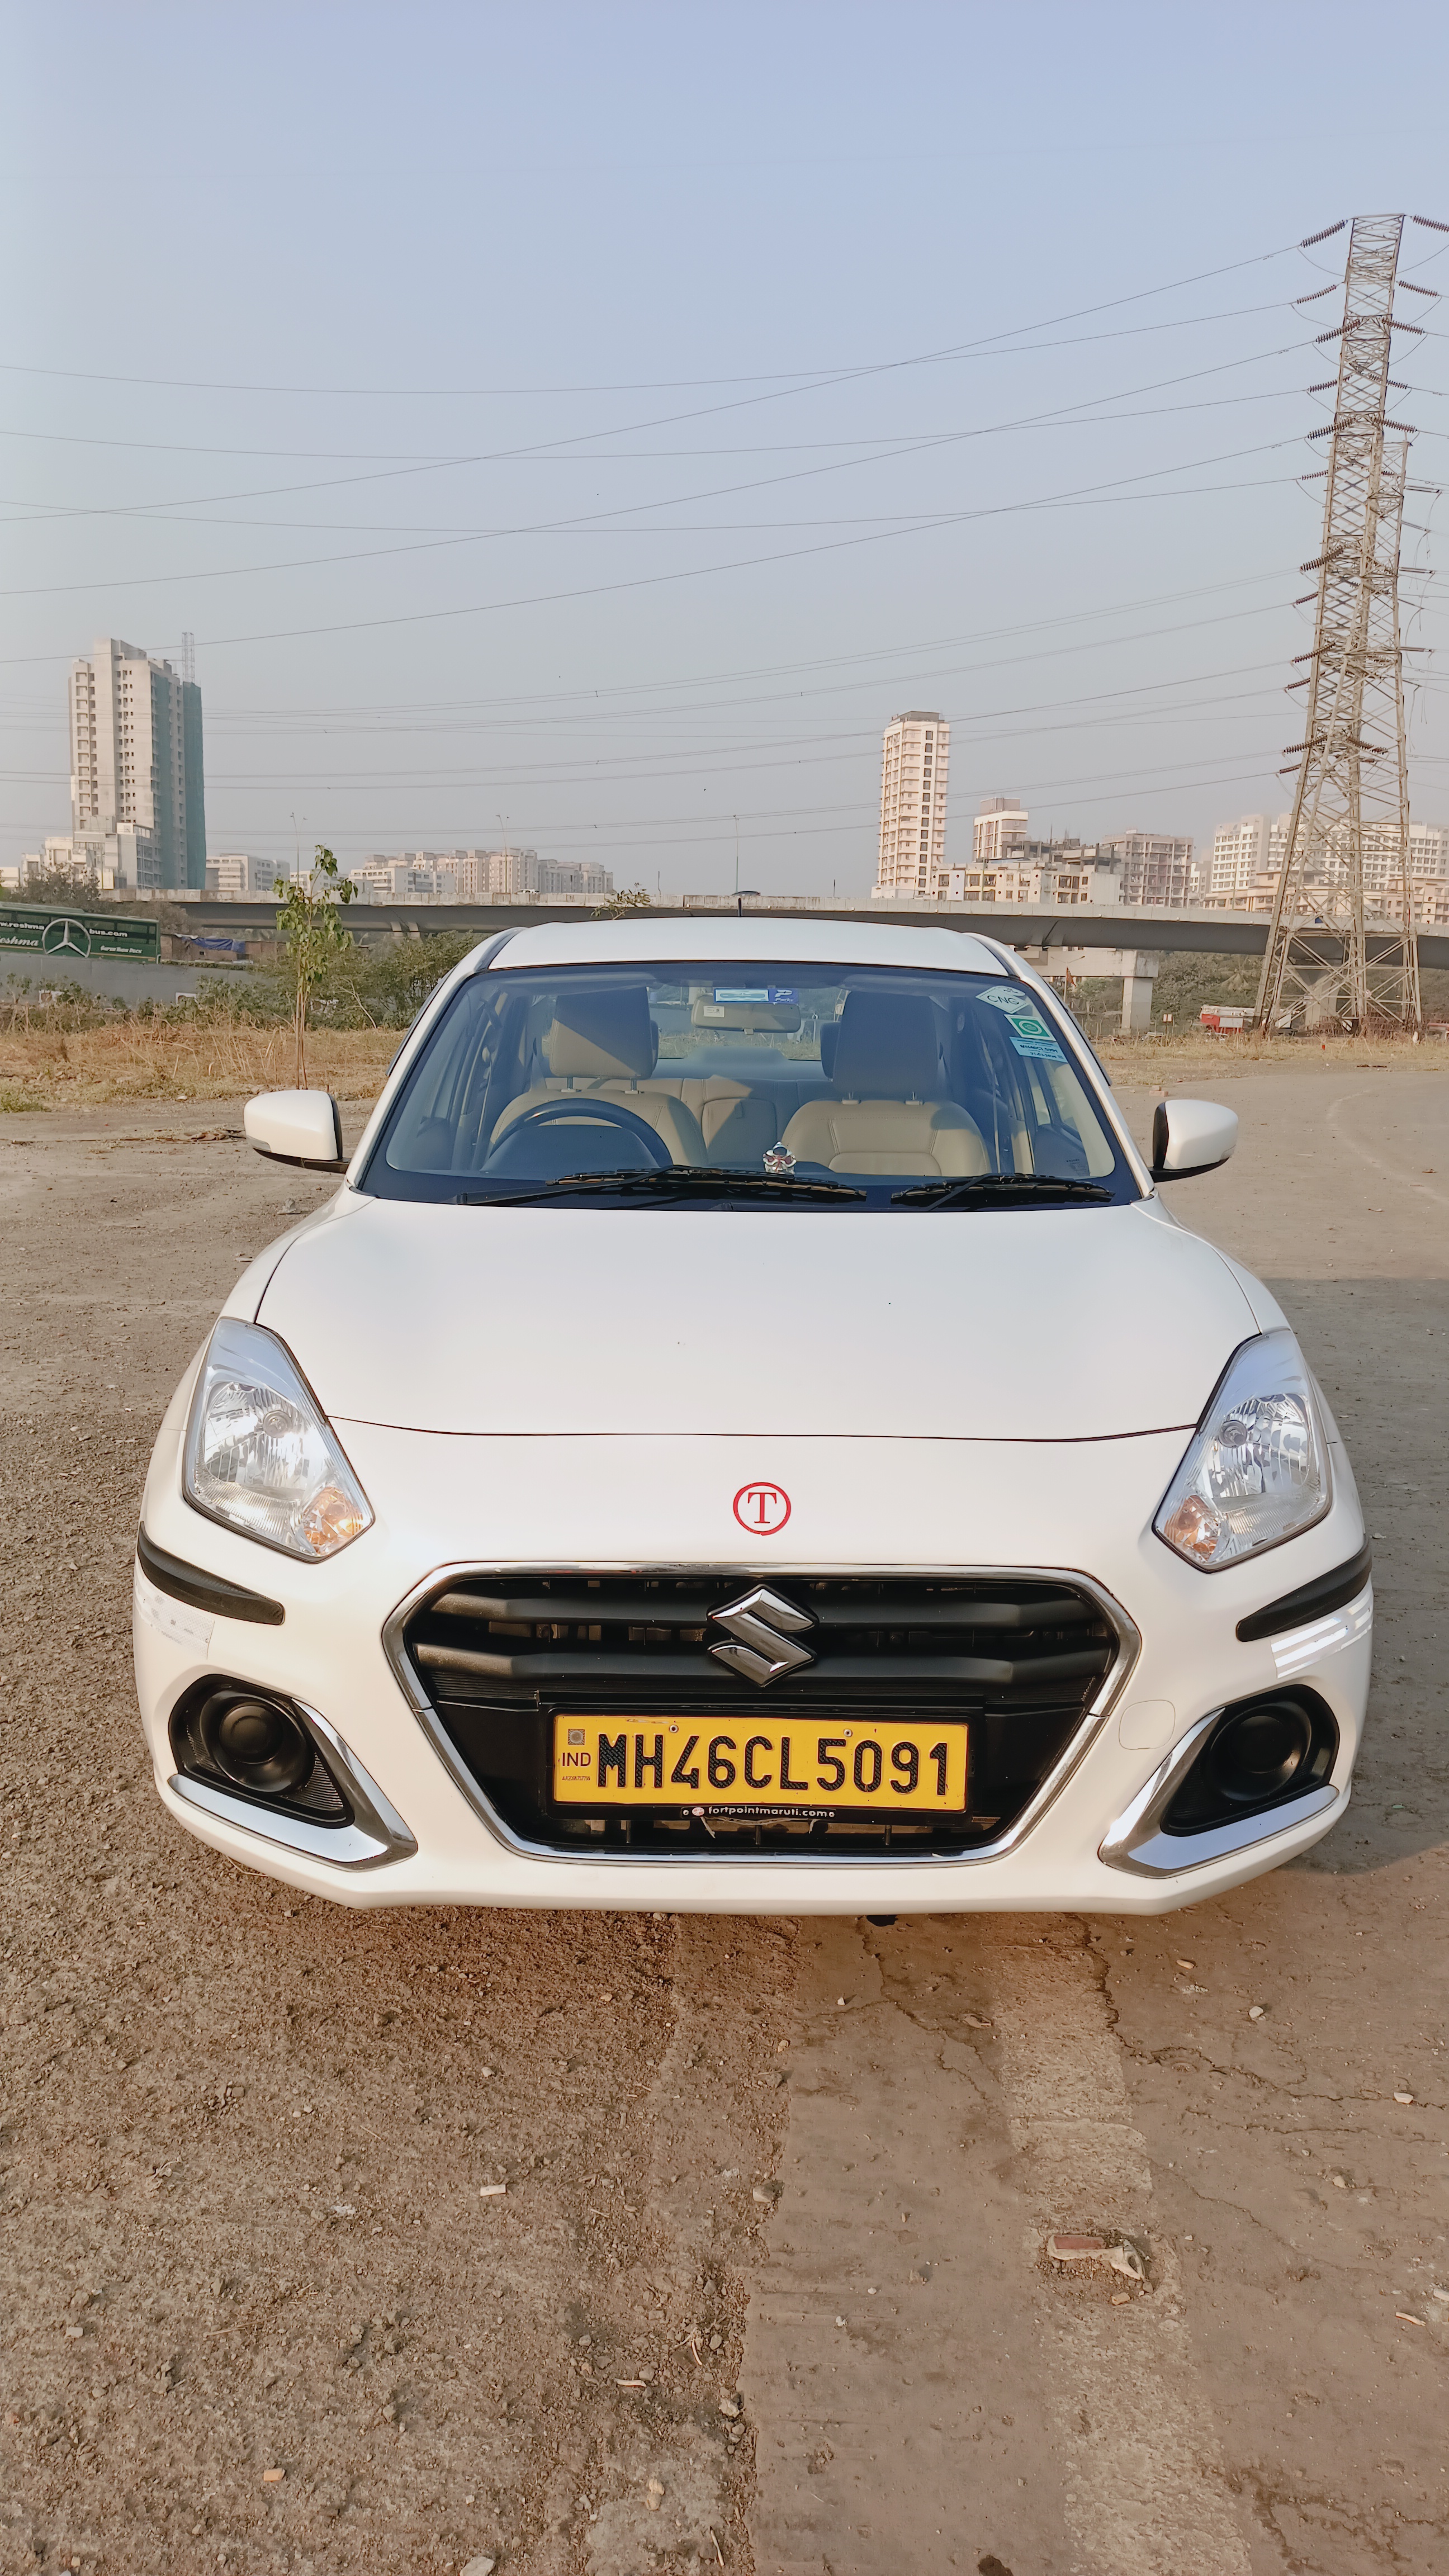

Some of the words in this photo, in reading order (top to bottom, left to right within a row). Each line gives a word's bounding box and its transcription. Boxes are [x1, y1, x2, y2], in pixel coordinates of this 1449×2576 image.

[89, 929, 128, 937] bus.com
[0, 936, 39, 946] eshma
[987, 996, 1019, 1005] CNG
[747, 1492, 777, 1523] T
[562, 1752, 591, 1767] IND
[598, 1734, 948, 1796] MH46CL5091
[708, 1806, 827, 1817] fortpointmaruti.com
